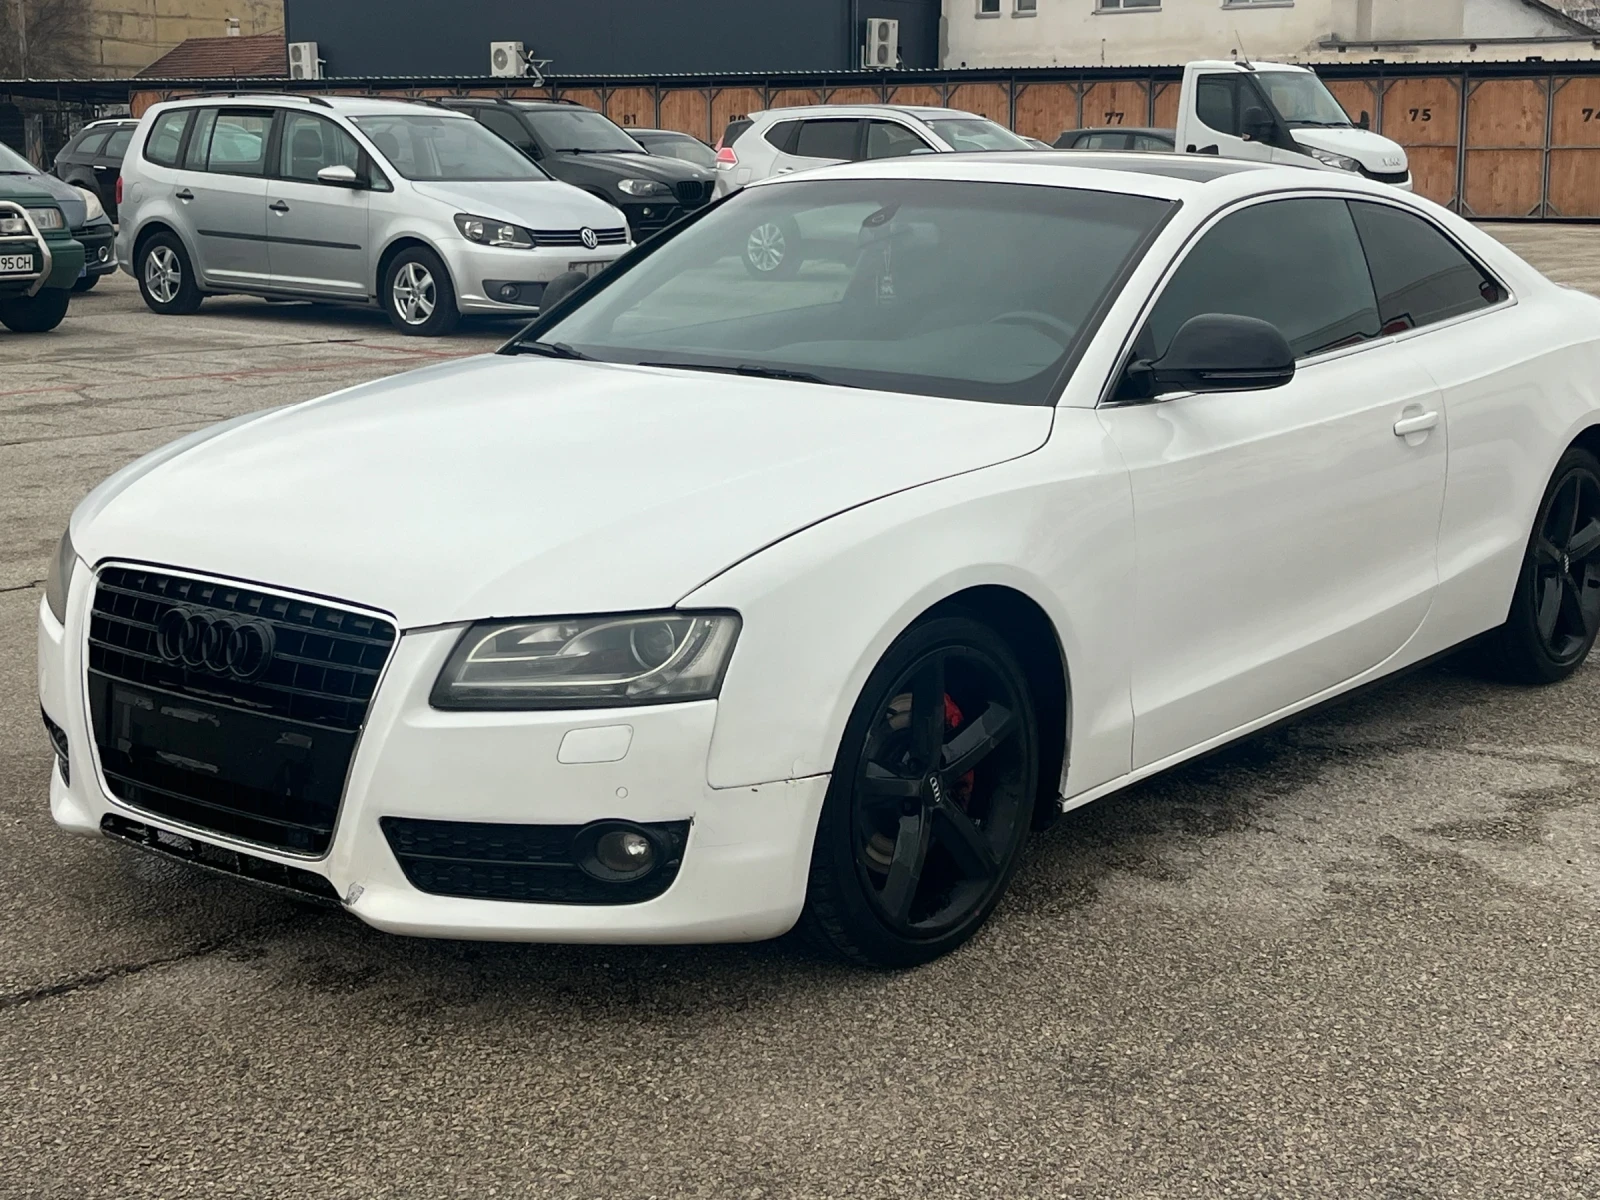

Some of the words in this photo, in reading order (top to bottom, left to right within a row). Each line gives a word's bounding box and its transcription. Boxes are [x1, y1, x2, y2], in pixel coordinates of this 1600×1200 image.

[623, 114, 637, 125] 81
[1104, 112, 1124, 125] 77
[1409, 108, 1432, 121] 75
[16, 256, 31, 269] CH
